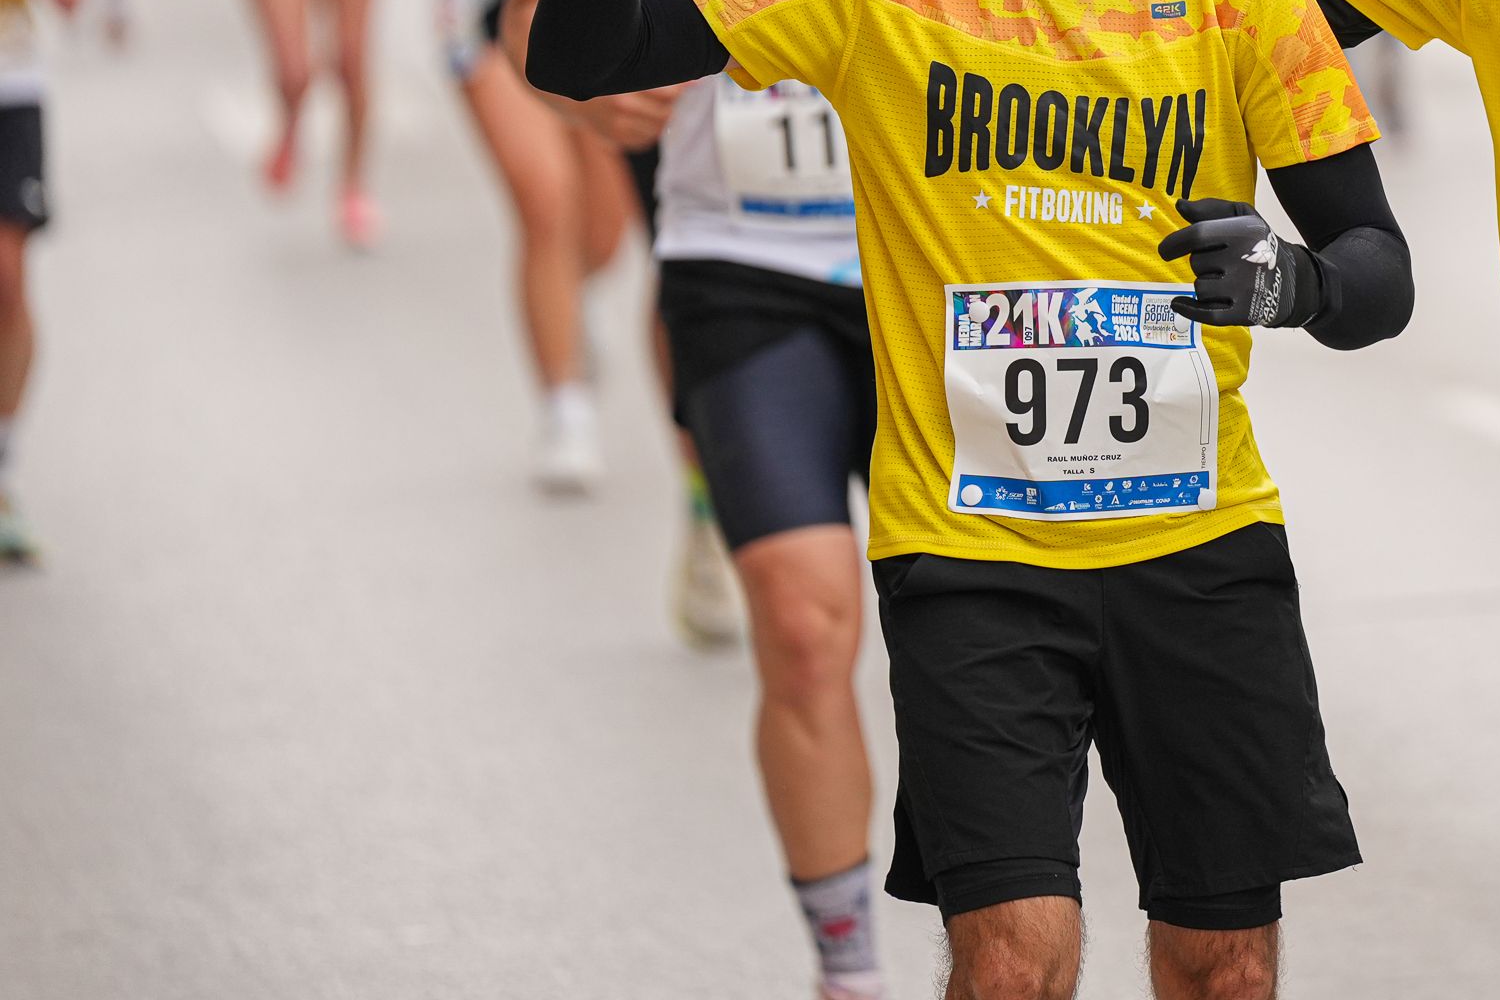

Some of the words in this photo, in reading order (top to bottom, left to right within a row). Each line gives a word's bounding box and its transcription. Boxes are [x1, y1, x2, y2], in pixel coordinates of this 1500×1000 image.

[924, 60, 1206, 200] BROOKLYN
[1004, 185, 1123, 224] FITBOXING
[1132, 295, 1139, 304] de
[1111, 303, 1138, 315] LUCENA
[1145, 303, 1171, 313] carre
[986, 292, 1066, 346] 21K
[1144, 310, 1175, 324] popula
[1113, 325, 1140, 342] 2026
[1143, 324, 1165, 332] Diputación
[1004, 356, 1149, 447] 973
[1070, 454, 1099, 462] MUÑOZ
